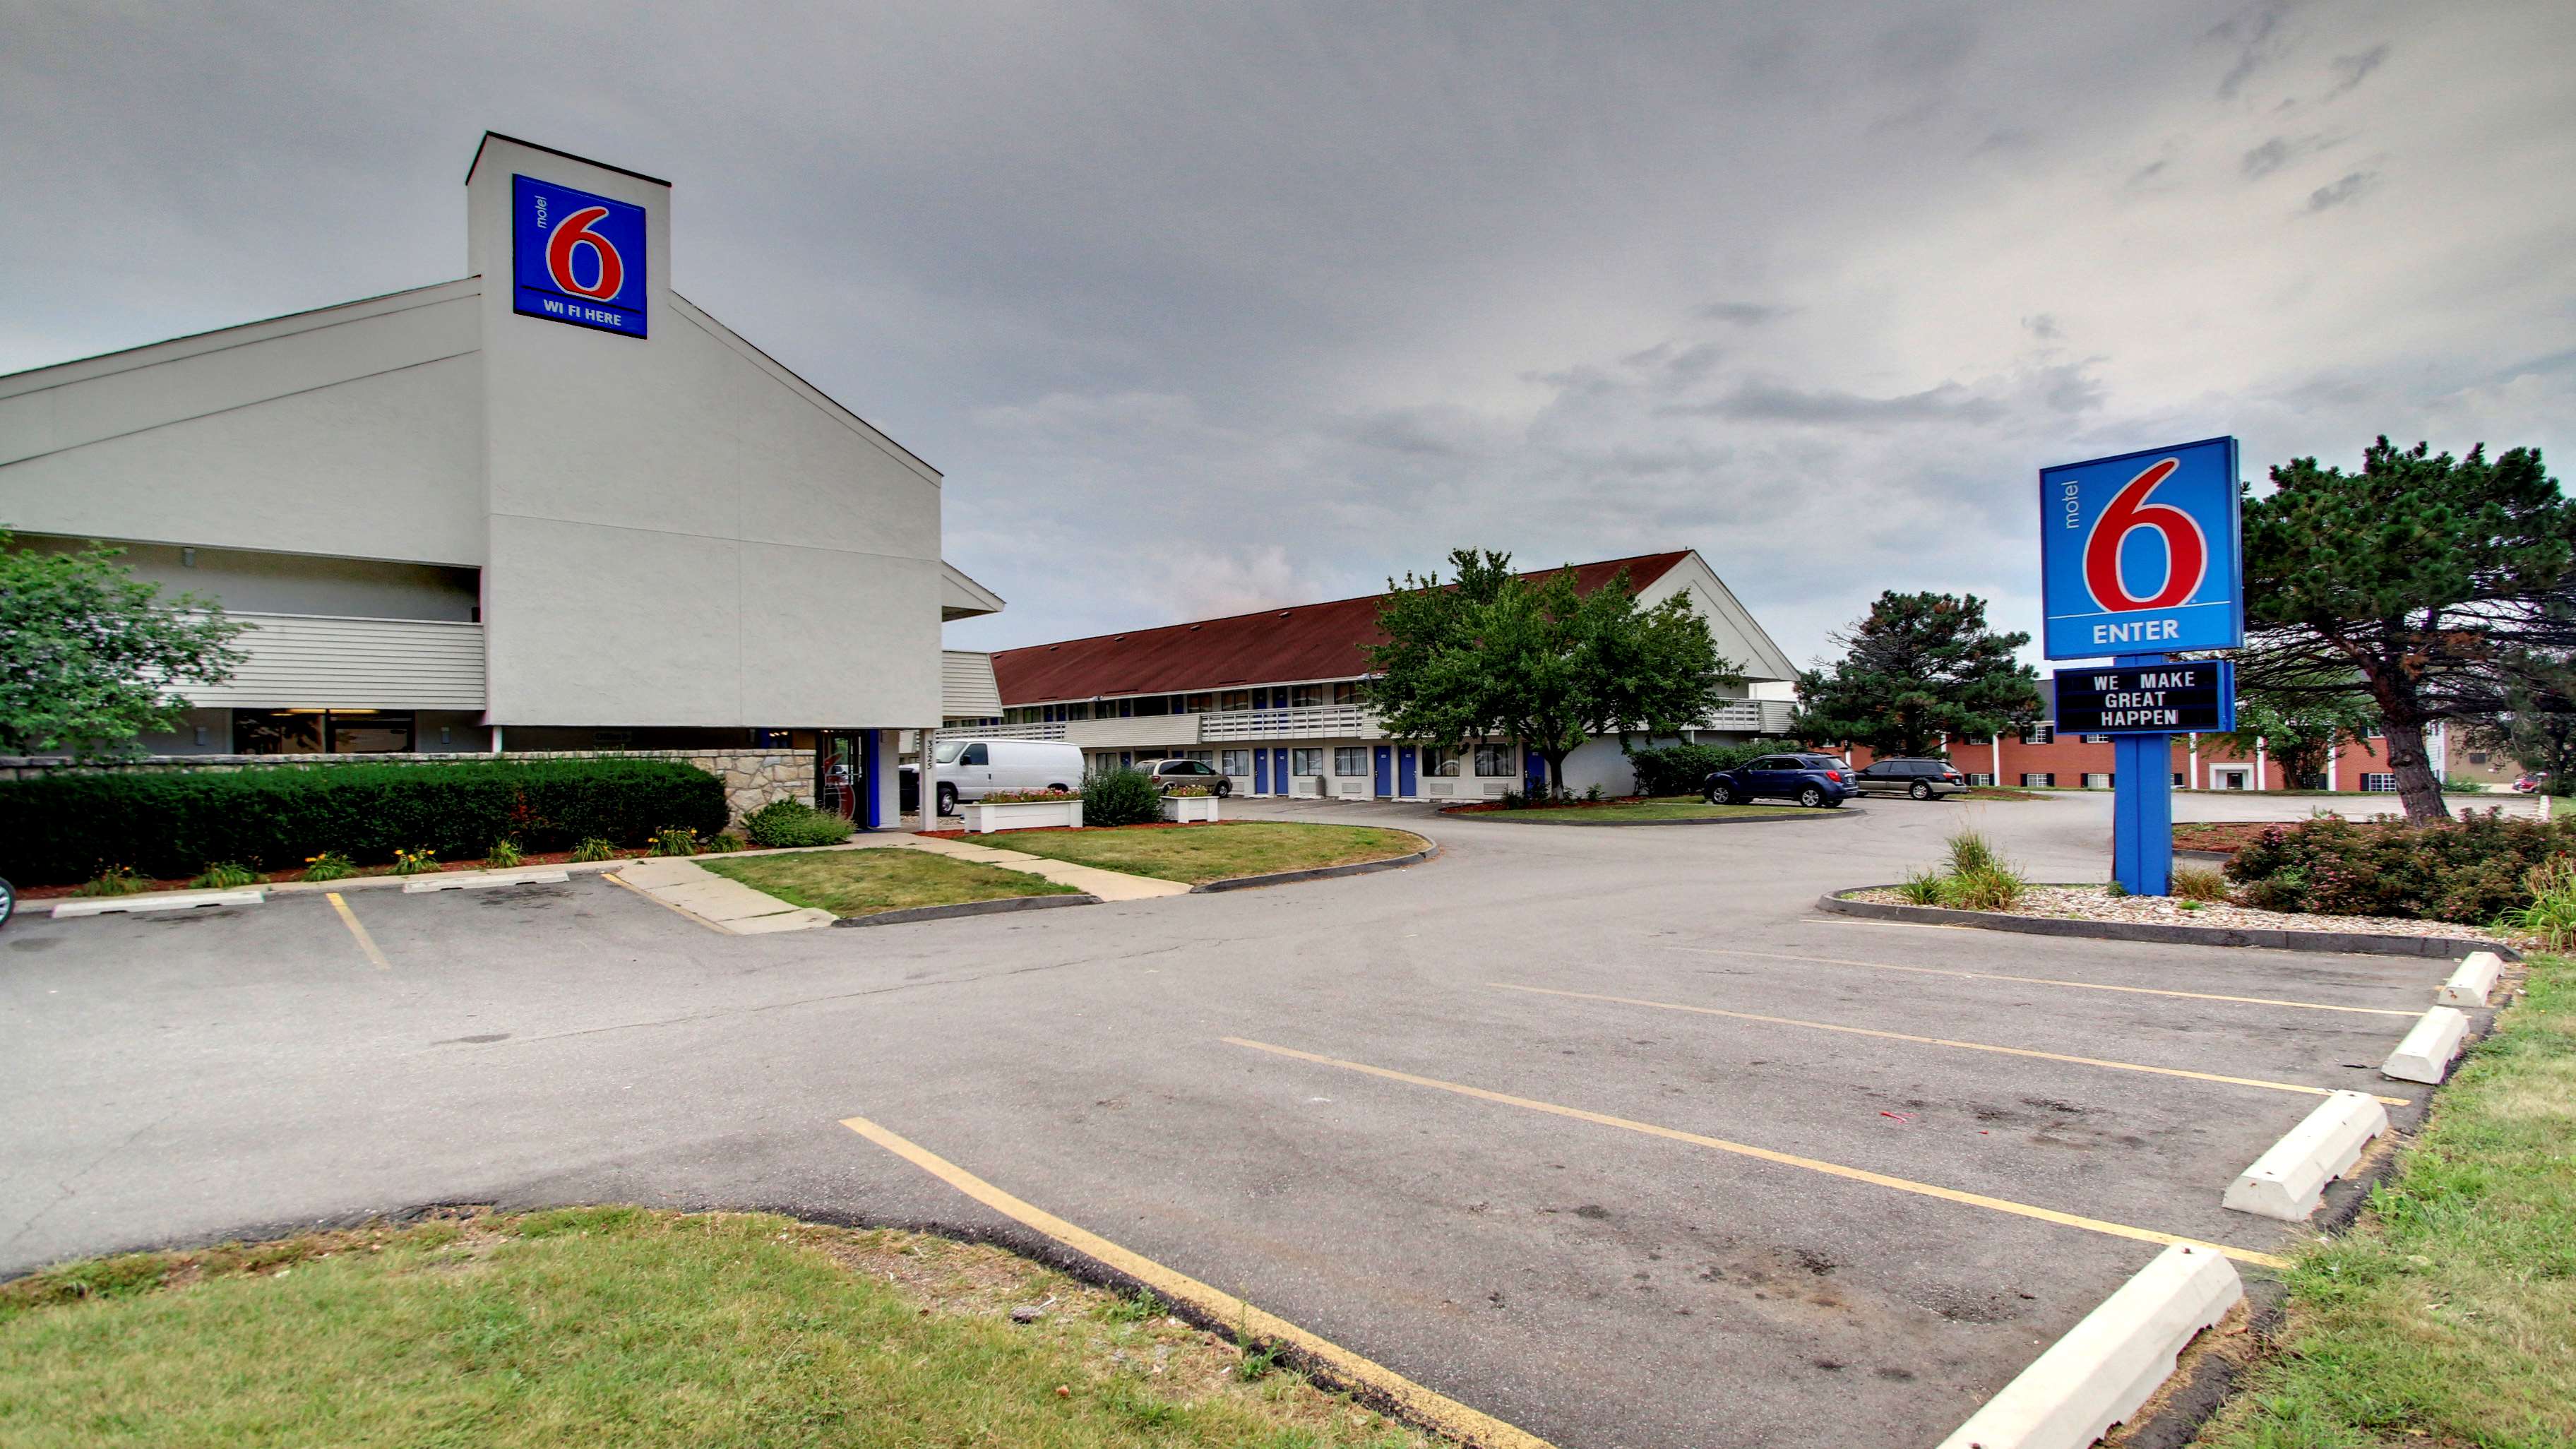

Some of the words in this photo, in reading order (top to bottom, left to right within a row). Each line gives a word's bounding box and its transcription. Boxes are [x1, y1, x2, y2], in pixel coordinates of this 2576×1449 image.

[534, 195, 547, 229] motel
[546, 205, 624, 302] 6
[543, 299, 564, 314] WI
[568, 304, 580, 318] FI
[585, 308, 621, 326] HERE
[2061, 479, 2080, 530] motel
[2082, 457, 2208, 614] 6
[2092, 619, 2179, 644] ENTER
[2094, 675, 2119, 691] WE
[2140, 672, 2195, 689] MAKE
[2105, 691, 2166, 708] GREAT
[2101, 709, 2177, 727] HAPPEN
